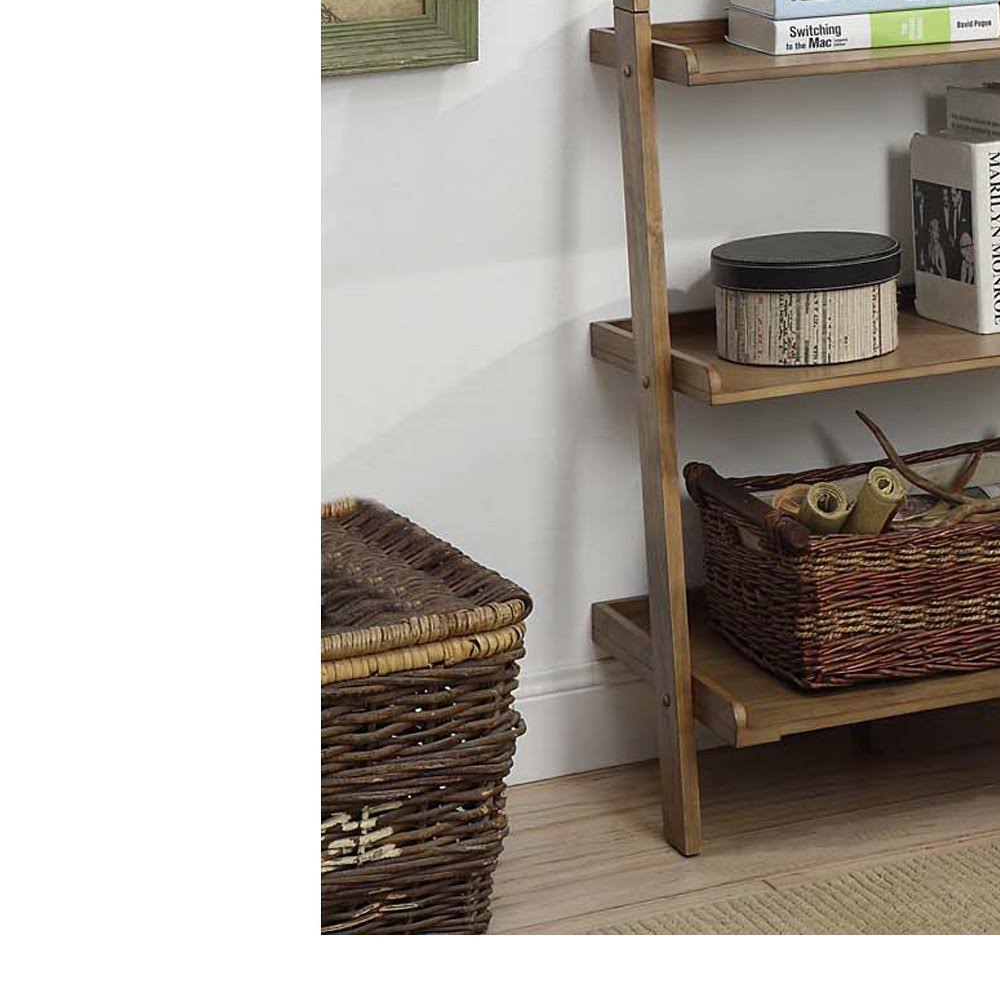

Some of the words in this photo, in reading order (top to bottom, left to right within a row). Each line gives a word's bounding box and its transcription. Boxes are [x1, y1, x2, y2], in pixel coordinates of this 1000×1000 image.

[789, 23, 842, 38] Switching
[957, 20, 973, 29] David
[786, 42, 793, 51] to
[795, 41, 806, 50] the
[808, 37, 832, 49] Mac
